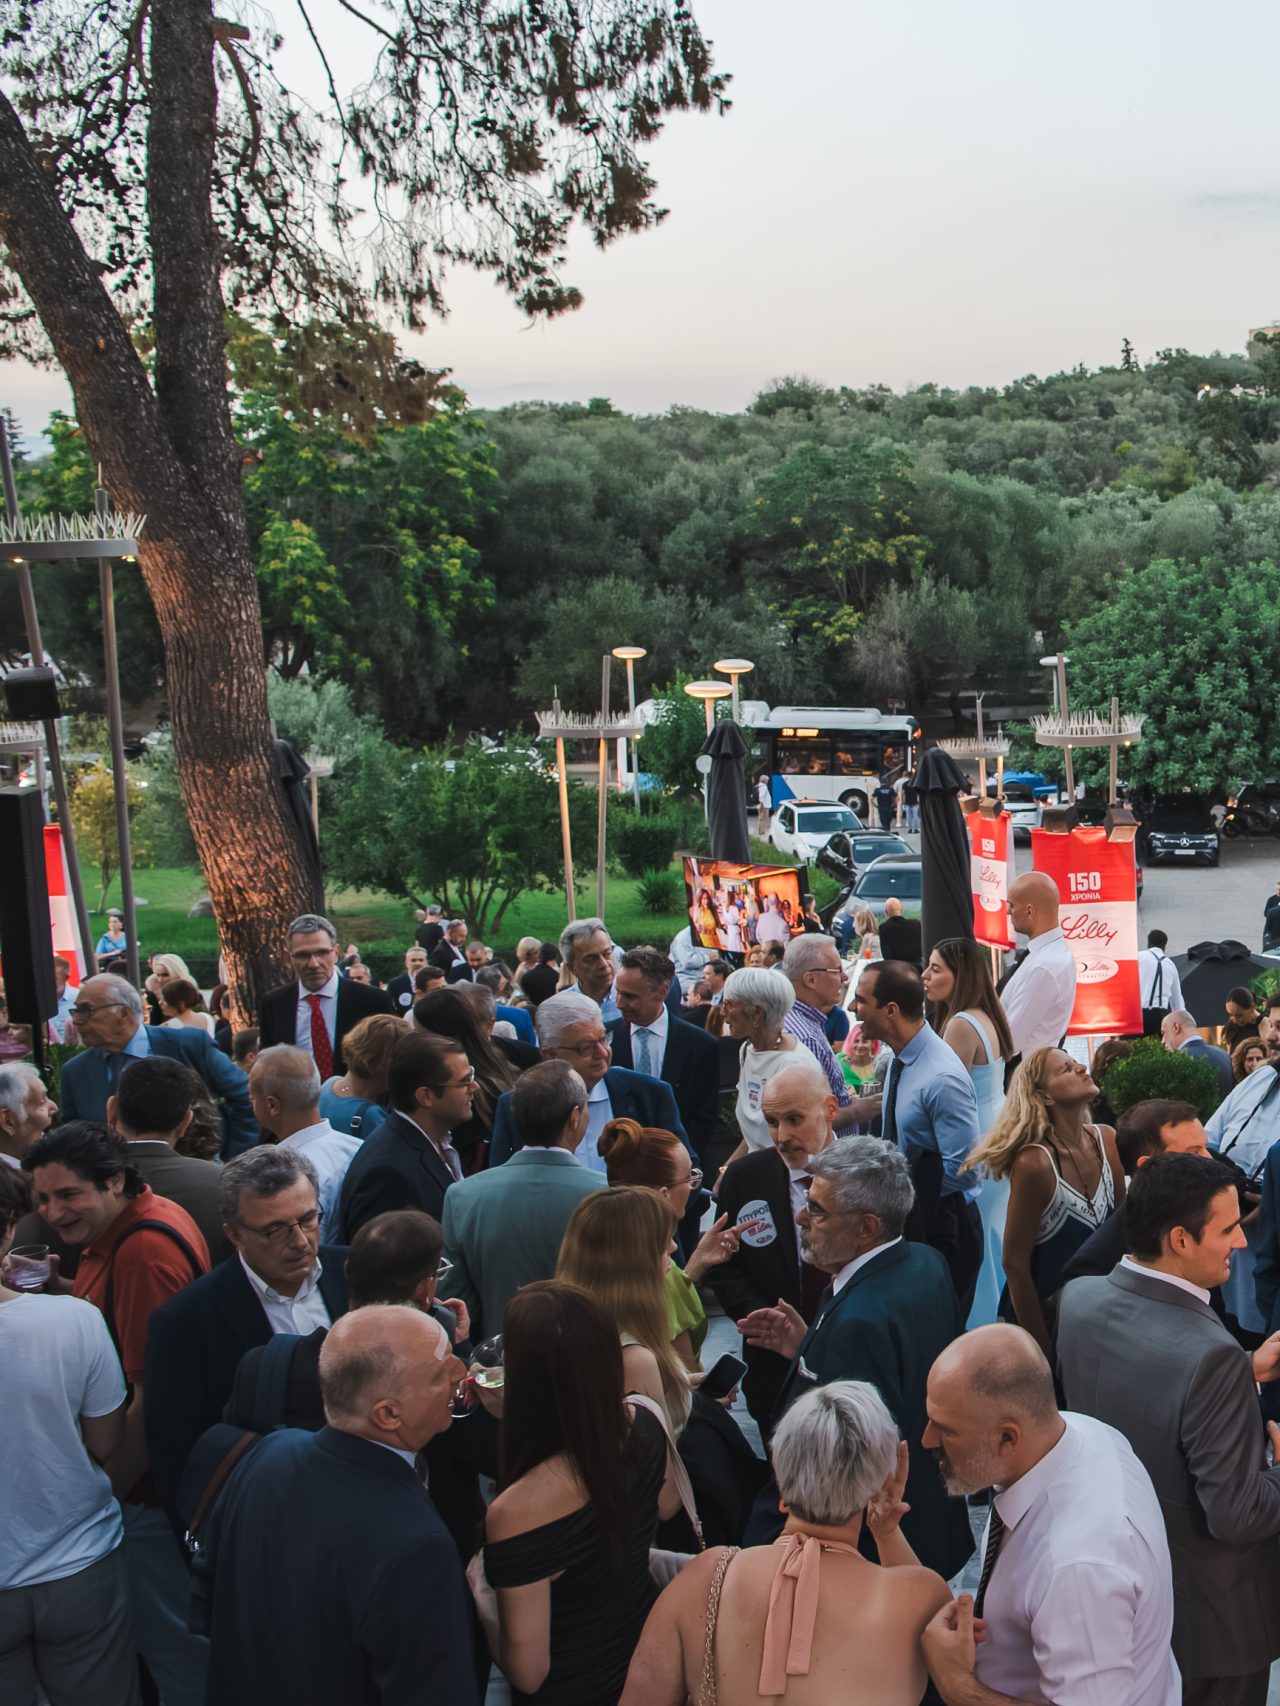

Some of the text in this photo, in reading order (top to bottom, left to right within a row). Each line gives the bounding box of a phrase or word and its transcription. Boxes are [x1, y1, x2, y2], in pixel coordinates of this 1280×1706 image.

[979, 865, 1002, 889] Lilly
[1067, 871, 1102, 892] 150
[1070, 892, 1101, 901] ΧΡΟΝΙΑ
[1060, 913, 1119, 946] Lilly
